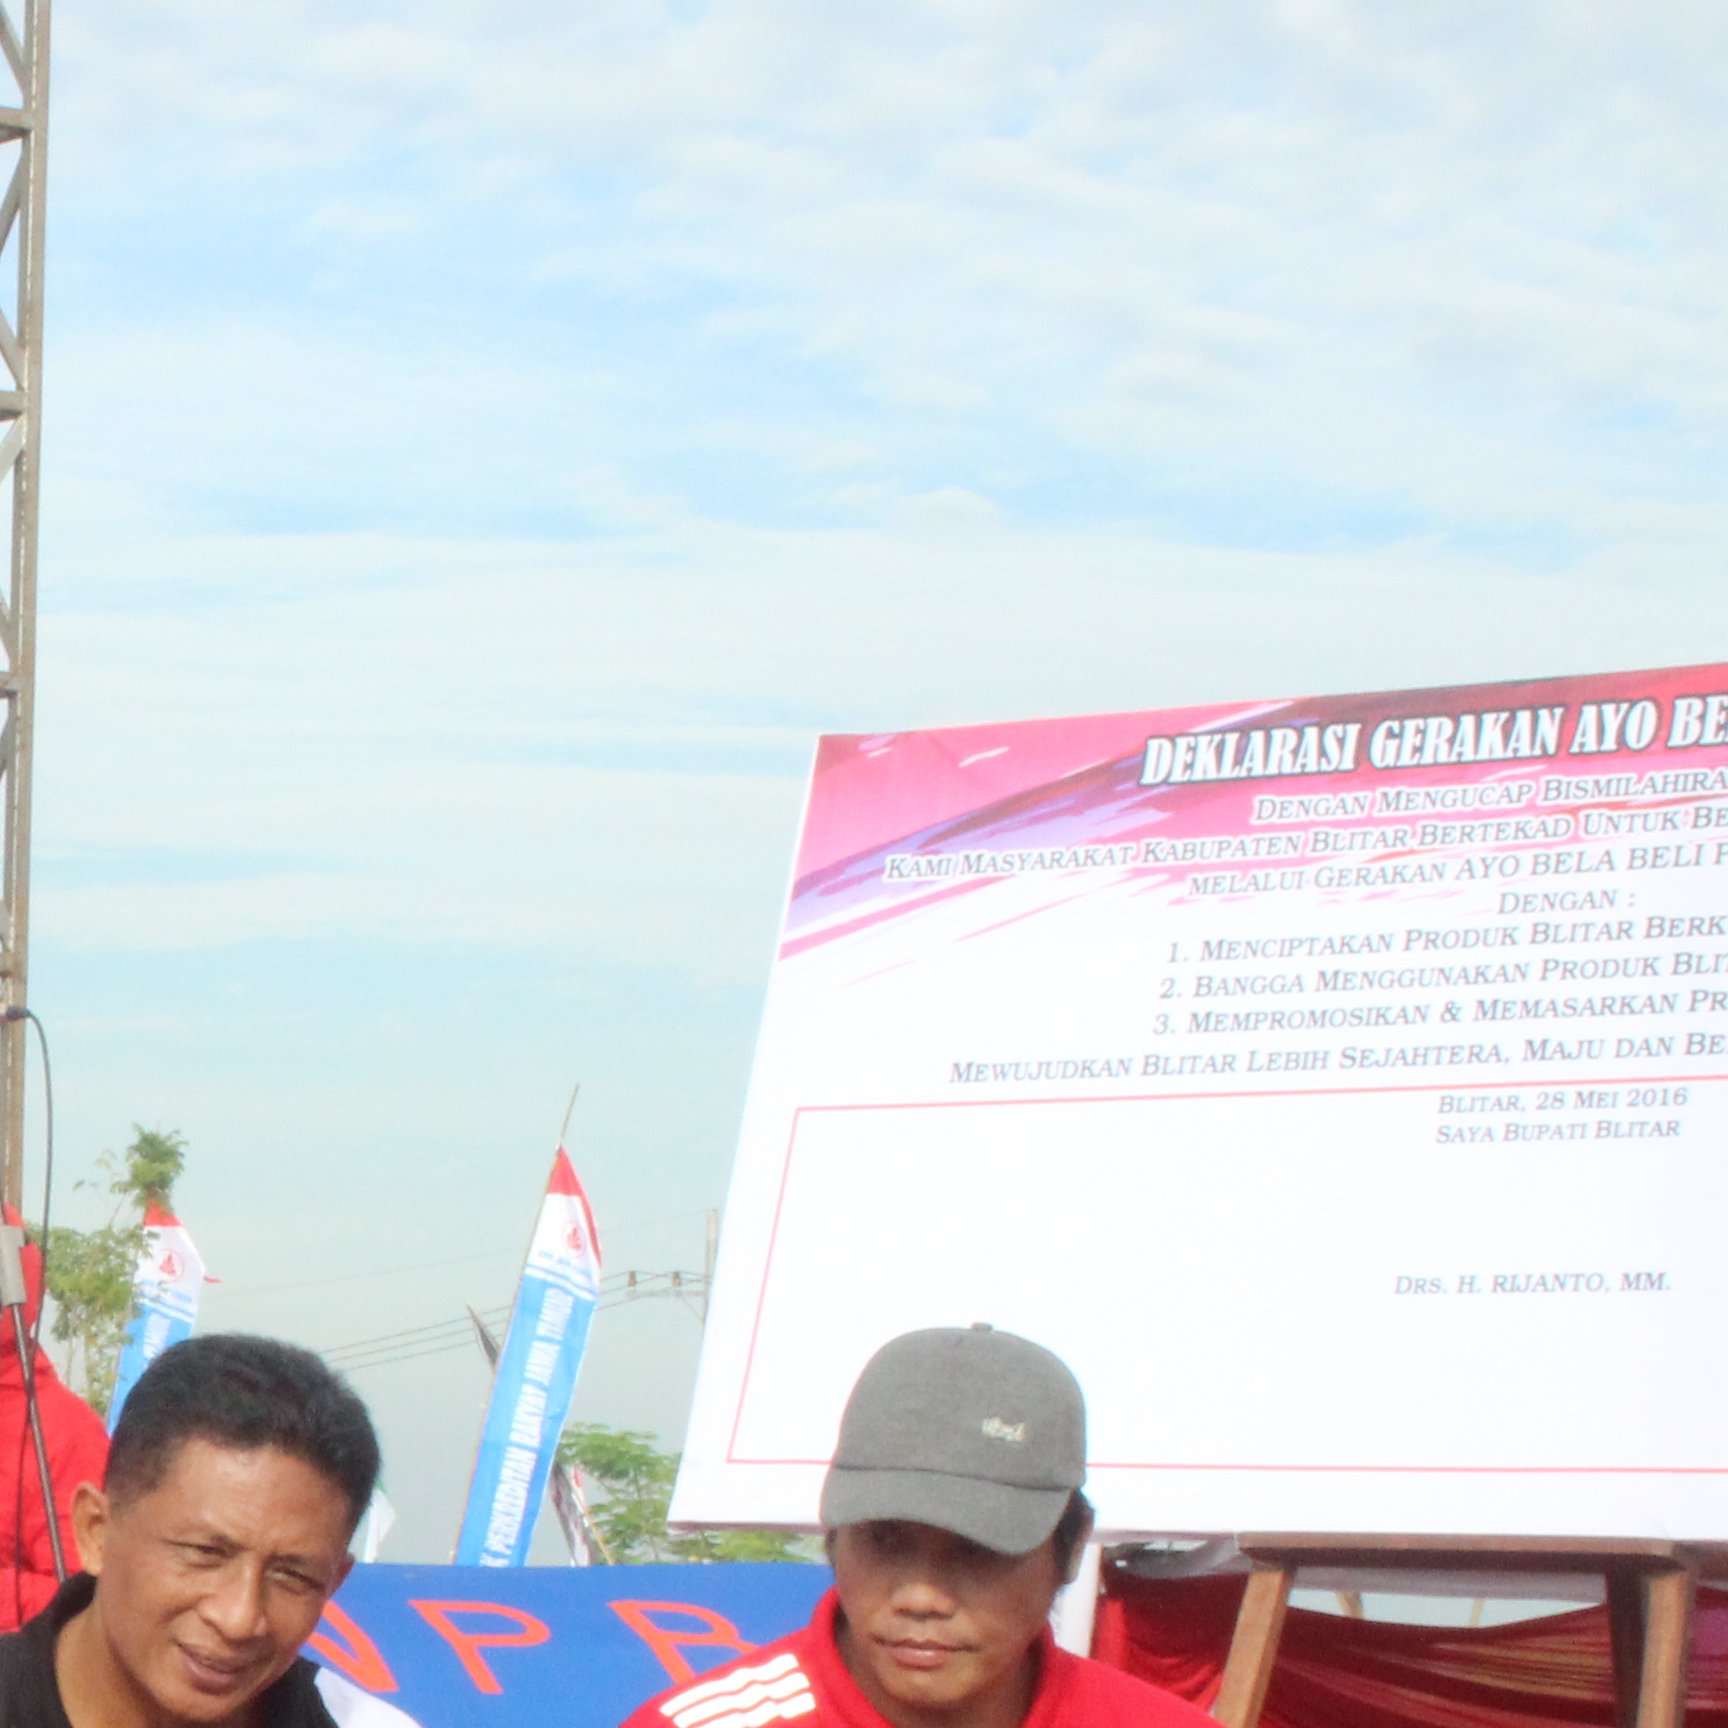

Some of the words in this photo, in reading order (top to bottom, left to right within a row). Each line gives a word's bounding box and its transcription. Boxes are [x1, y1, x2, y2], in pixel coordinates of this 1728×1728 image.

[1139, 721, 1362, 786] DEKLARASI
[1369, 706, 1566, 770] GERAKAN
[1570, 698, 1659, 755] AYO
[1255, 795, 1368, 821] DENGAN
[1377, 783, 1534, 814] MENGUCAP
[887, 857, 953, 879] KAMI
[959, 846, 1135, 875] MASYARAKAT
[1143, 835, 1303, 863] KABUPATEN
[1310, 827, 1409, 853] BLITAR
[1418, 818, 1572, 847] BERTEKAD
[1582, 809, 1681, 836] UNTUK
[1187, 870, 1305, 896] MELALUI
[1314, 861, 1447, 889] GERAKAN
[1454, 855, 1521, 882] AYO
[1530, 849, 1613, 877] BELA
[1626, 842, 1706, 871] BELI
[1497, 888, 1619, 914] DENGAN
[1166, 941, 1190, 964] 1.
[1198, 932, 1395, 963] MENCIPTAKAN
[1403, 925, 1521, 952] PRODUK
[1529, 919, 1635, 945] BLITAR
[1158, 977, 1183, 1000] 2.
[1192, 973, 1306, 998] BANGGA
[1315, 961, 1530, 993] MENGGUNAKAN
[1538, 955, 1662, 981] PRODUK
[1152, 1013, 1177, 1036] 3.
[1186, 1004, 1432, 1034] MEMPROMOSIKAN
[1439, 1001, 1462, 1023] &
[1472, 992, 1680, 1022] MEMASARKAN
[948, 1056, 1134, 1084] MEWUJUDKAN
[1139, 1053, 1238, 1077] BLITAR
[1245, 1049, 1331, 1073] LEBIH
[1522, 1038, 1607, 1062] MAJU
[1613, 1035, 1675, 1059] DAN
[1535, 1092, 1566, 1111] 28
[1572, 1090, 1619, 1110] MEI
[1626, 1086, 1689, 1108] 2016
[1435, 1125, 1497, 1145] SAYA
[1502, 1122, 1589, 1143] BUPATI
[1594, 1119, 1683, 1140] BLITAR
[524, 1340, 561, 1387] JAWA
[509, 1383, 548, 1449] RAKYAT
